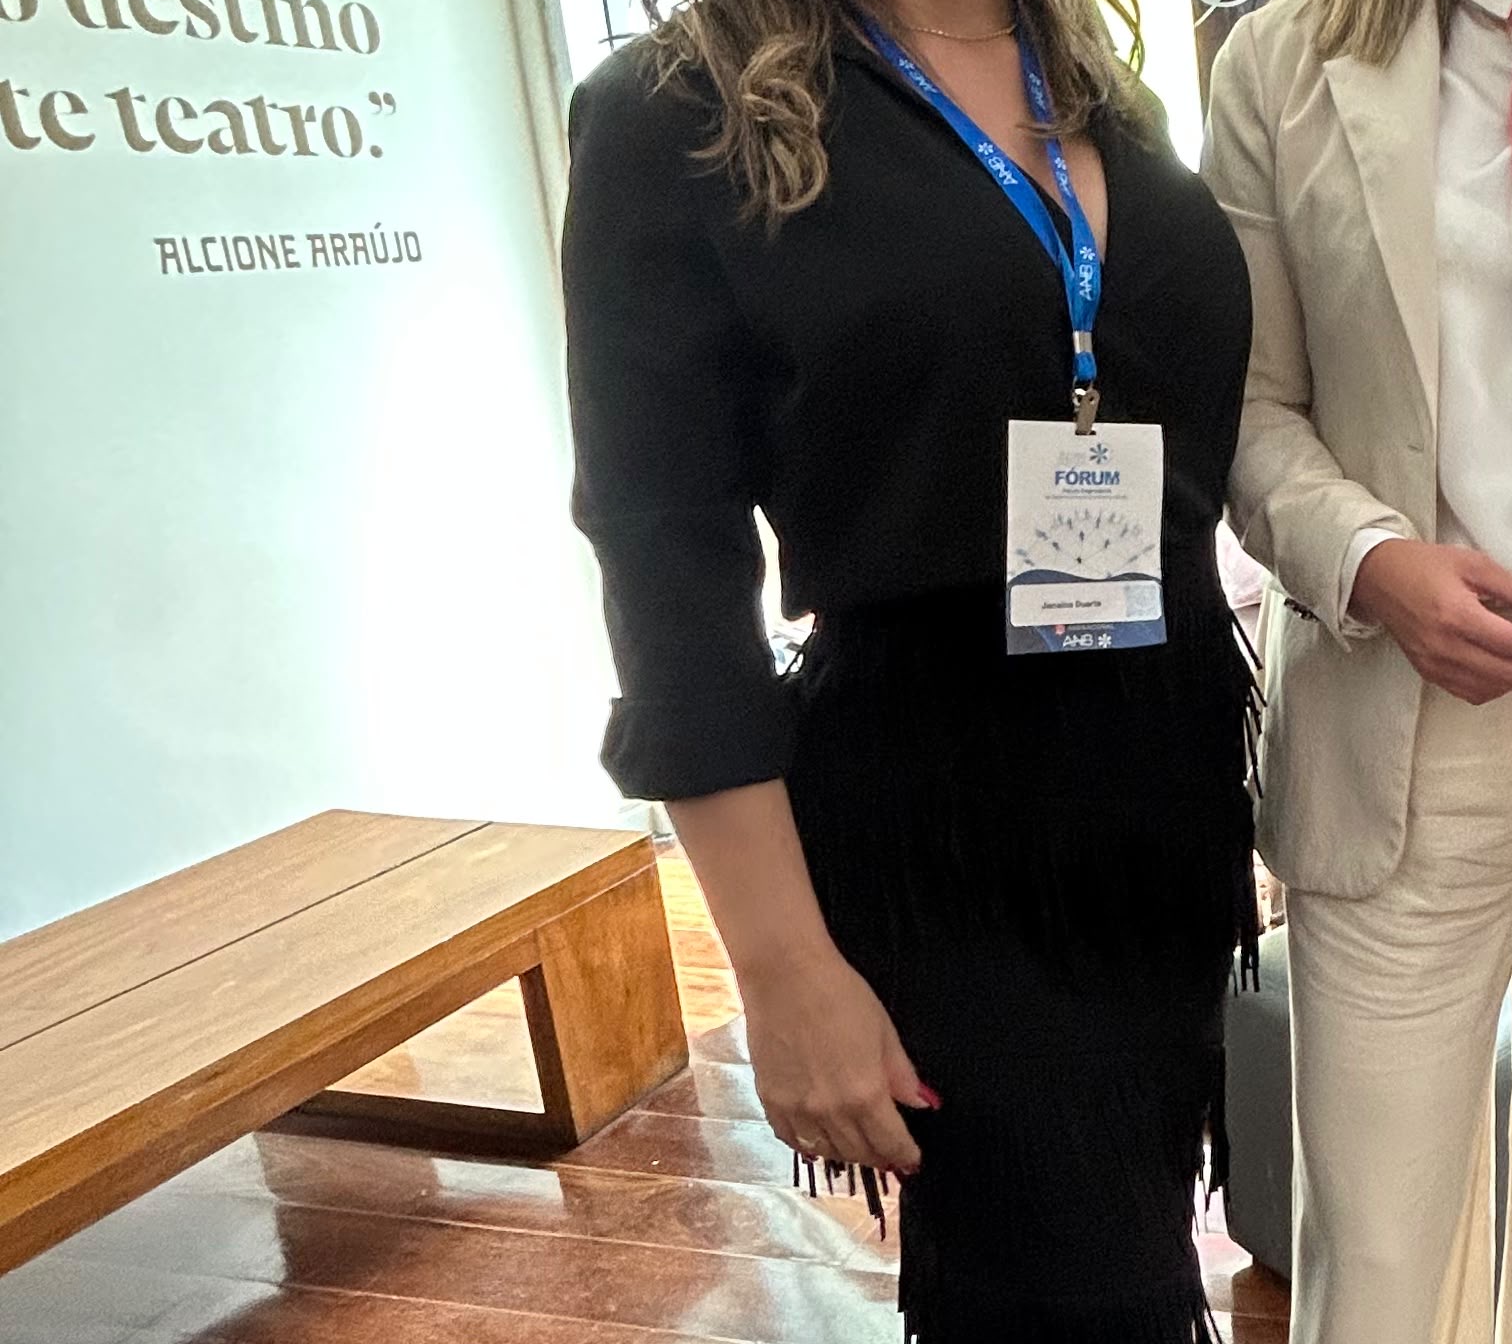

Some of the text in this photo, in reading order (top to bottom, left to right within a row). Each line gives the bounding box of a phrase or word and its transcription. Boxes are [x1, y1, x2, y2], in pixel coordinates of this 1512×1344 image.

[987, 156, 1018, 185] ANB
[153, 221, 423, 276] ALCIONE ARAÚJO
[1079, 264, 1093, 301] ANB
[1055, 467, 1120, 486] FÓRUM
[1062, 633, 1093, 648] ANB
